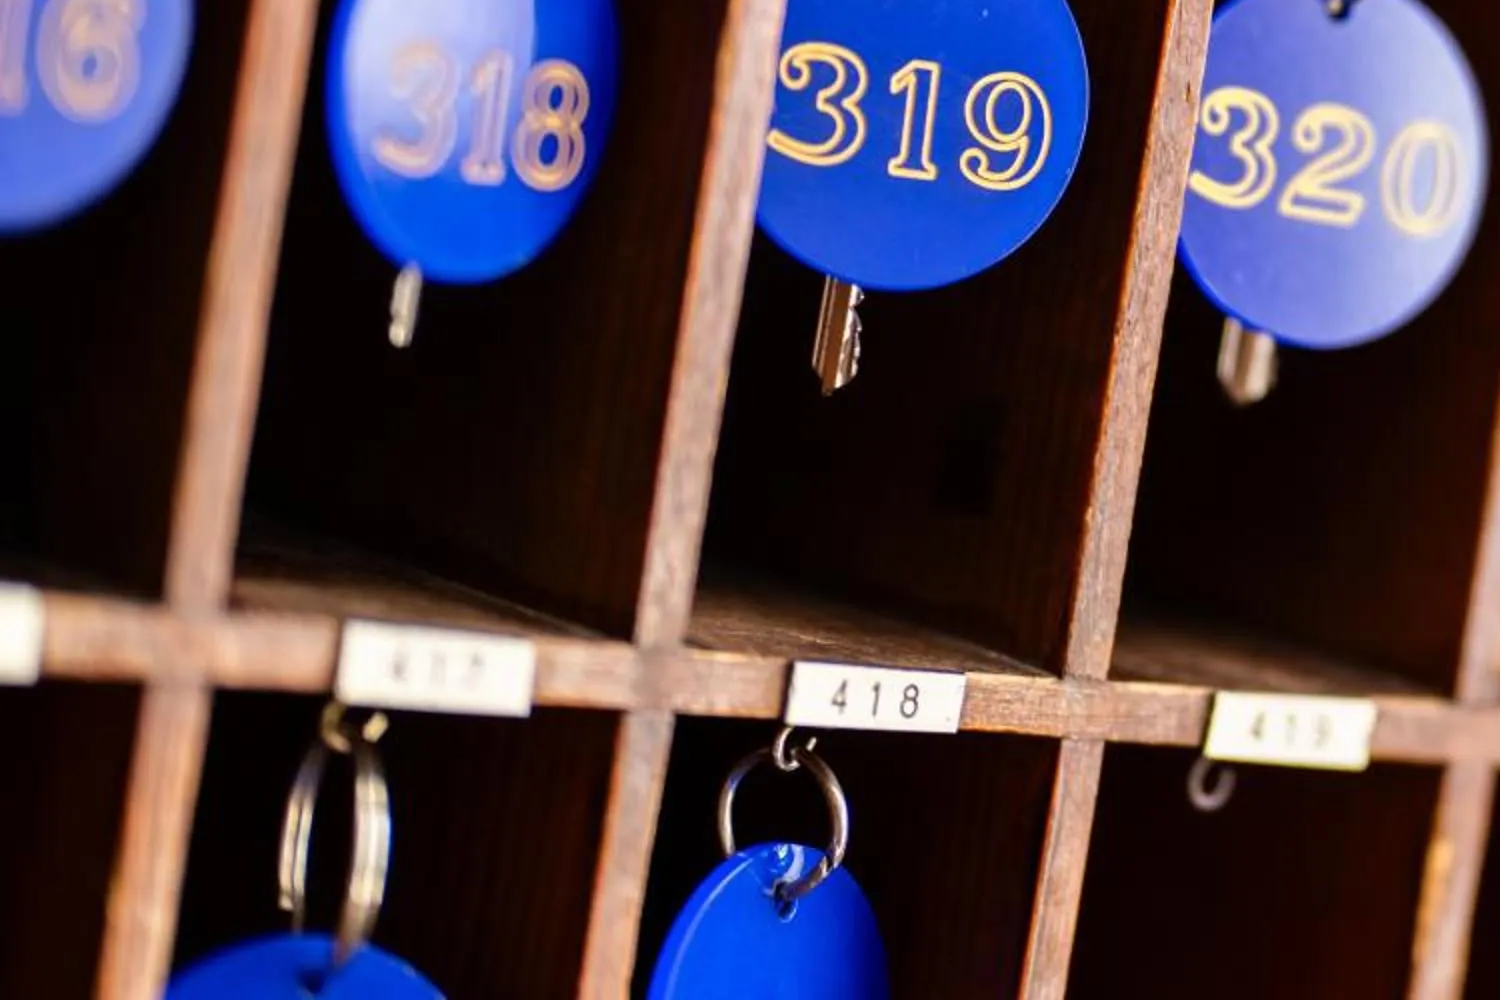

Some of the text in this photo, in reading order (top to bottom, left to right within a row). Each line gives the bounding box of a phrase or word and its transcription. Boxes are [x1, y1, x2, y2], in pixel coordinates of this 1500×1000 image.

[374, 36, 591, 193] 318
[766, 41, 1053, 192] 319
[1188, 85, 1466, 238] 320
[830, 679, 920, 719] 418
